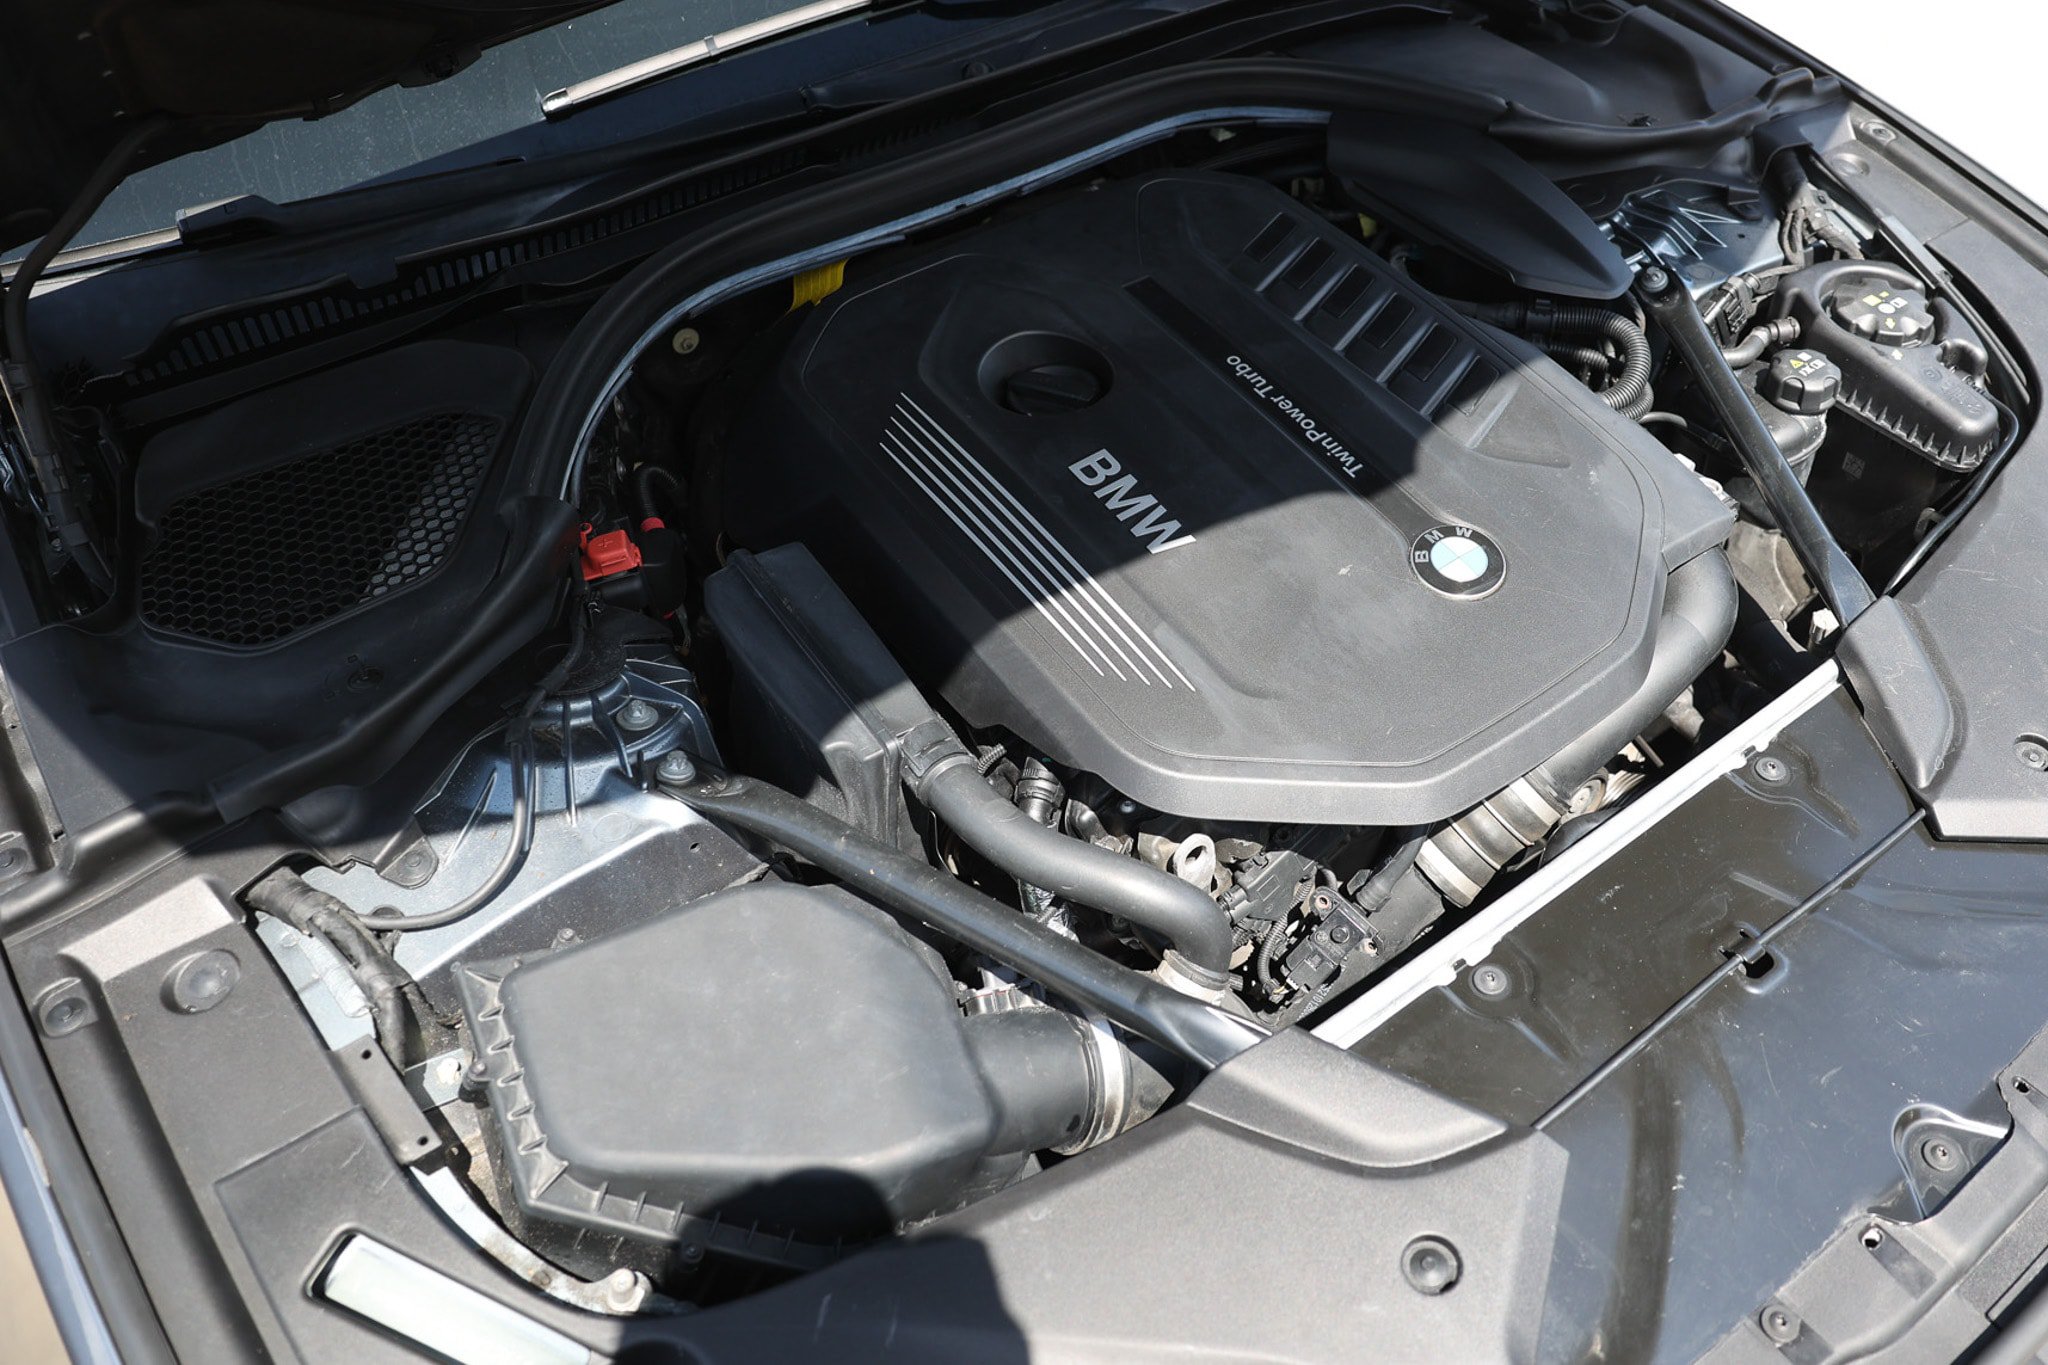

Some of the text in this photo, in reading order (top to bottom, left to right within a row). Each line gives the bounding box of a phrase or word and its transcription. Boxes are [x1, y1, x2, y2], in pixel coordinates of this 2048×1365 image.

[1226, 355, 1364, 478] TwinPower Turbo
[1067, 448, 1197, 555] BMW
[1414, 526, 1474, 564] BMW
